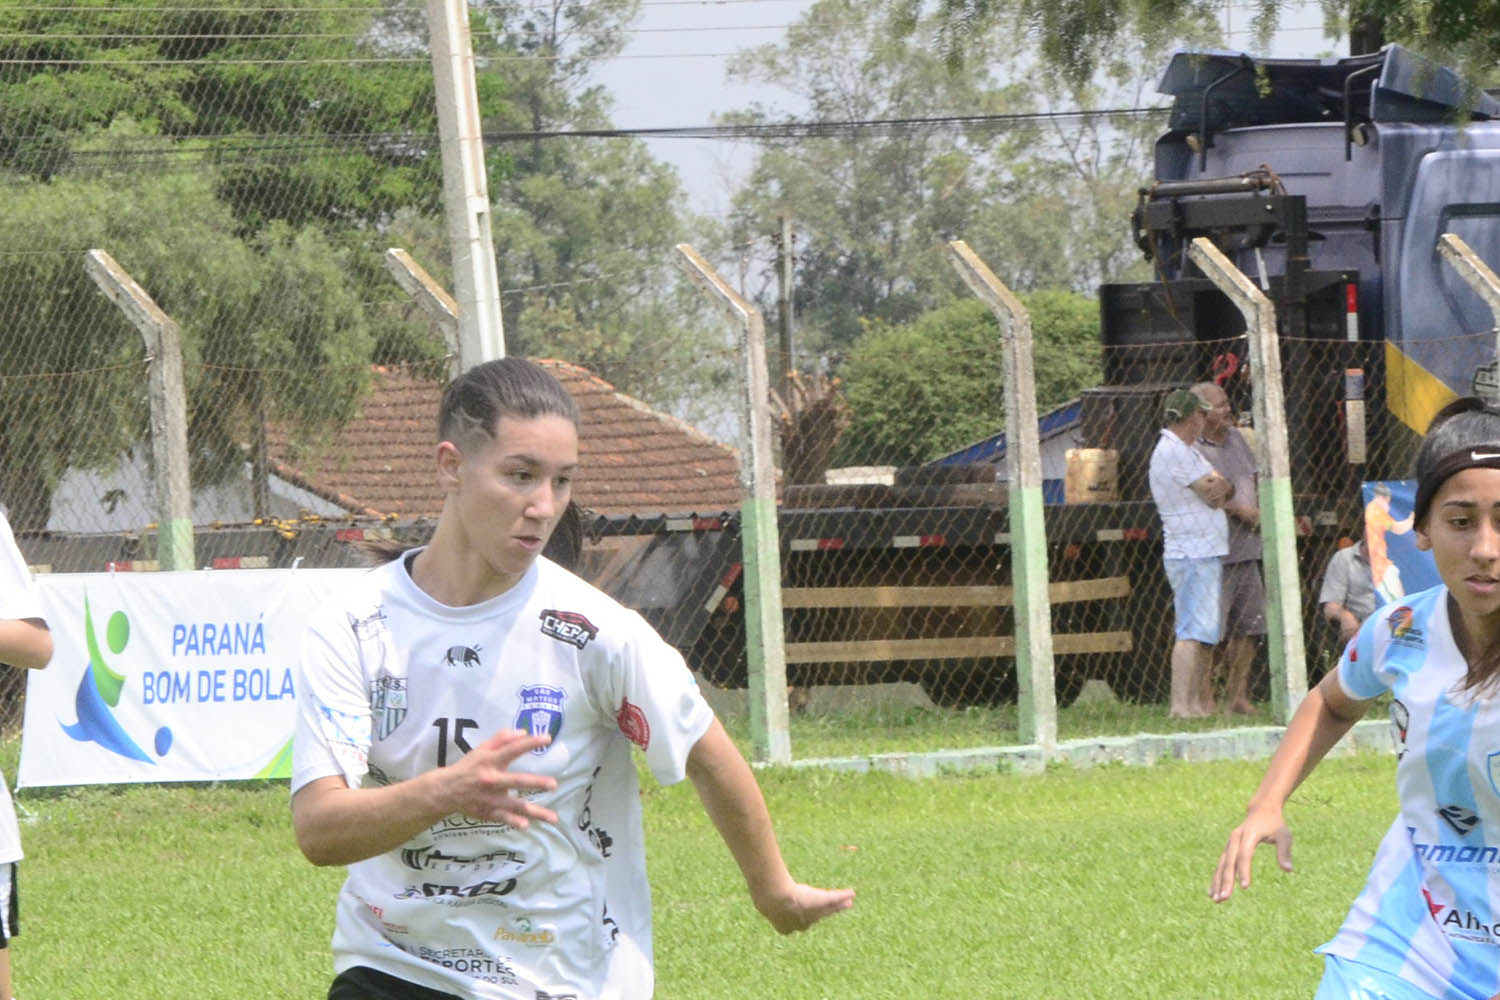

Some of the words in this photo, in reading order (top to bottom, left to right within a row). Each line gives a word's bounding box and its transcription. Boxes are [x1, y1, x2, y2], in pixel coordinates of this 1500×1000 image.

[172, 611, 266, 657] PARANÁ
[143, 670, 191, 705] BOM
[197, 669, 227, 703] DE
[232, 667, 296, 702] BOLA
[432, 717, 481, 768] 15
[420, 956, 517, 977] PORTES
